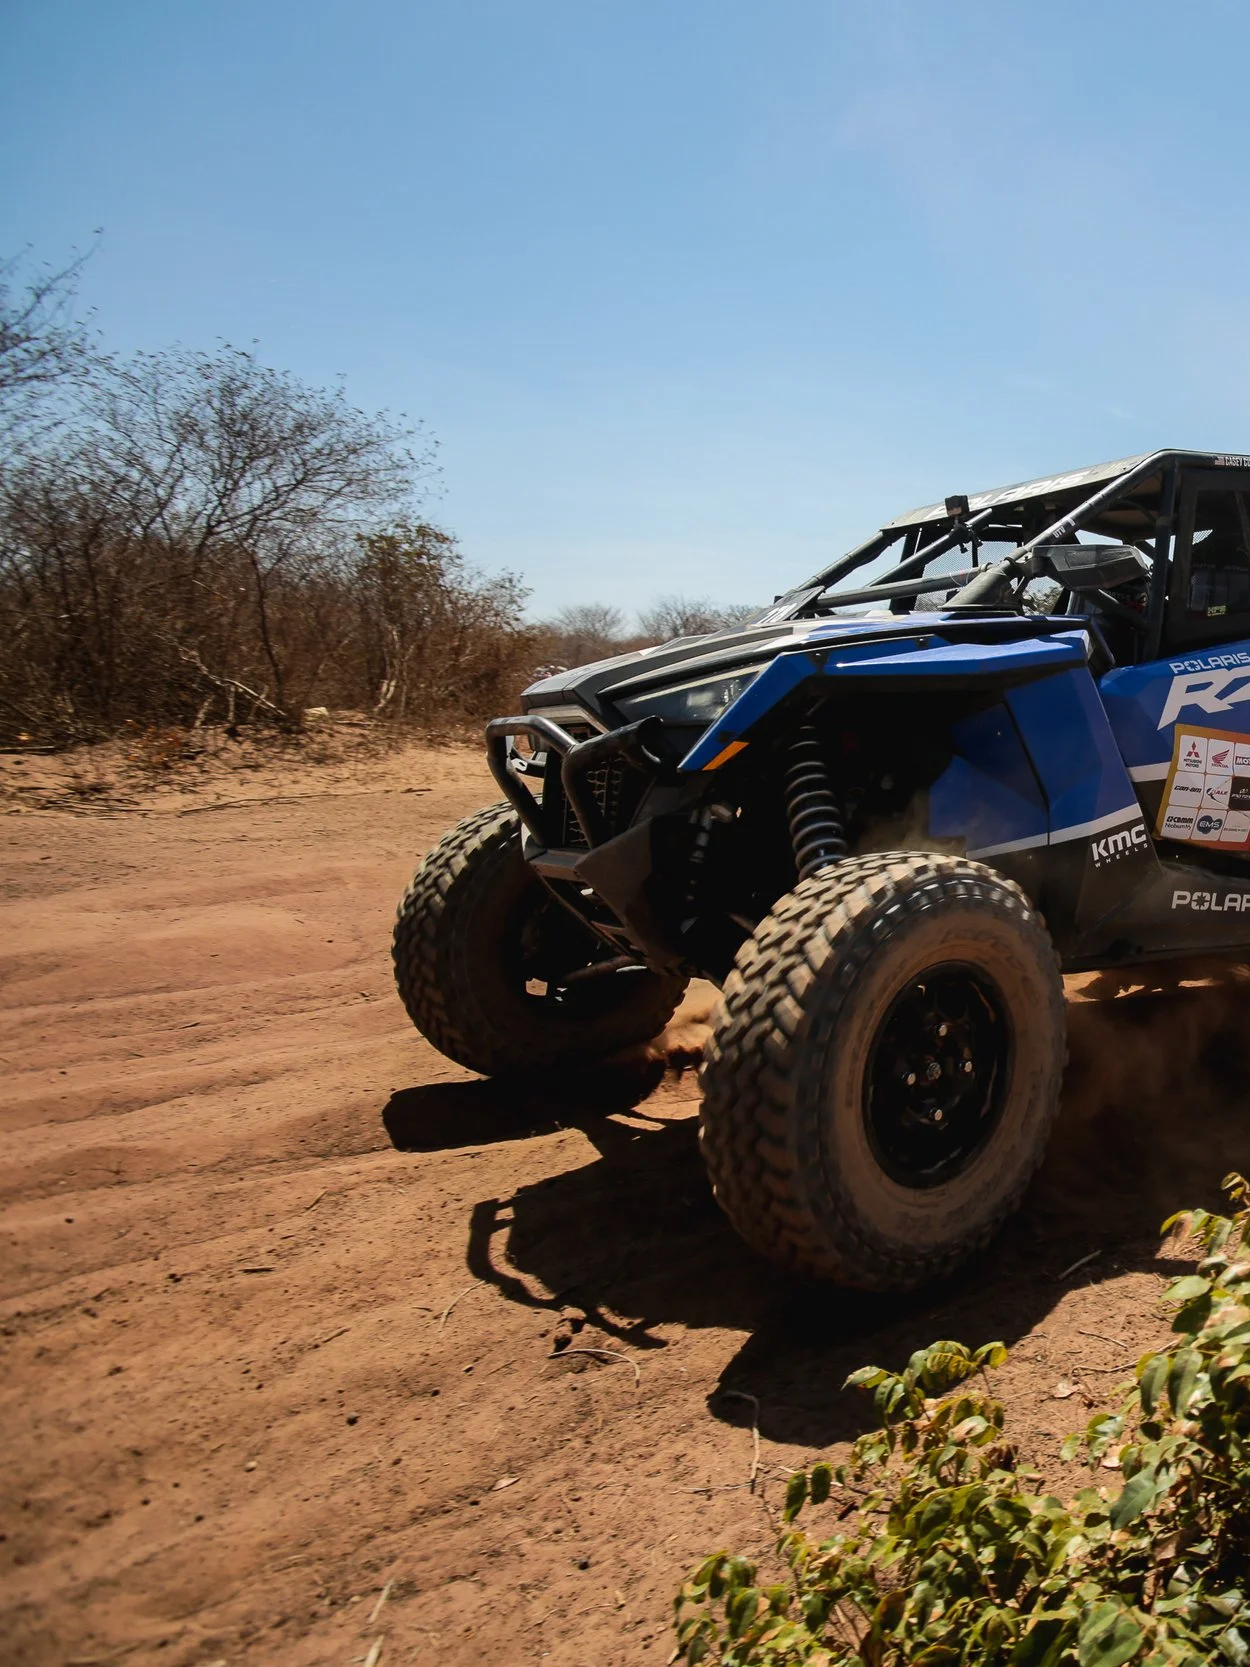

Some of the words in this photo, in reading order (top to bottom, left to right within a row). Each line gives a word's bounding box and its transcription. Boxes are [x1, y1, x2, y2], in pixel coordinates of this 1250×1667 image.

[924, 471, 1090, 519] PLARIS
[1092, 824, 1147, 861] KMC
[1200, 820, 1220, 828] EMS
